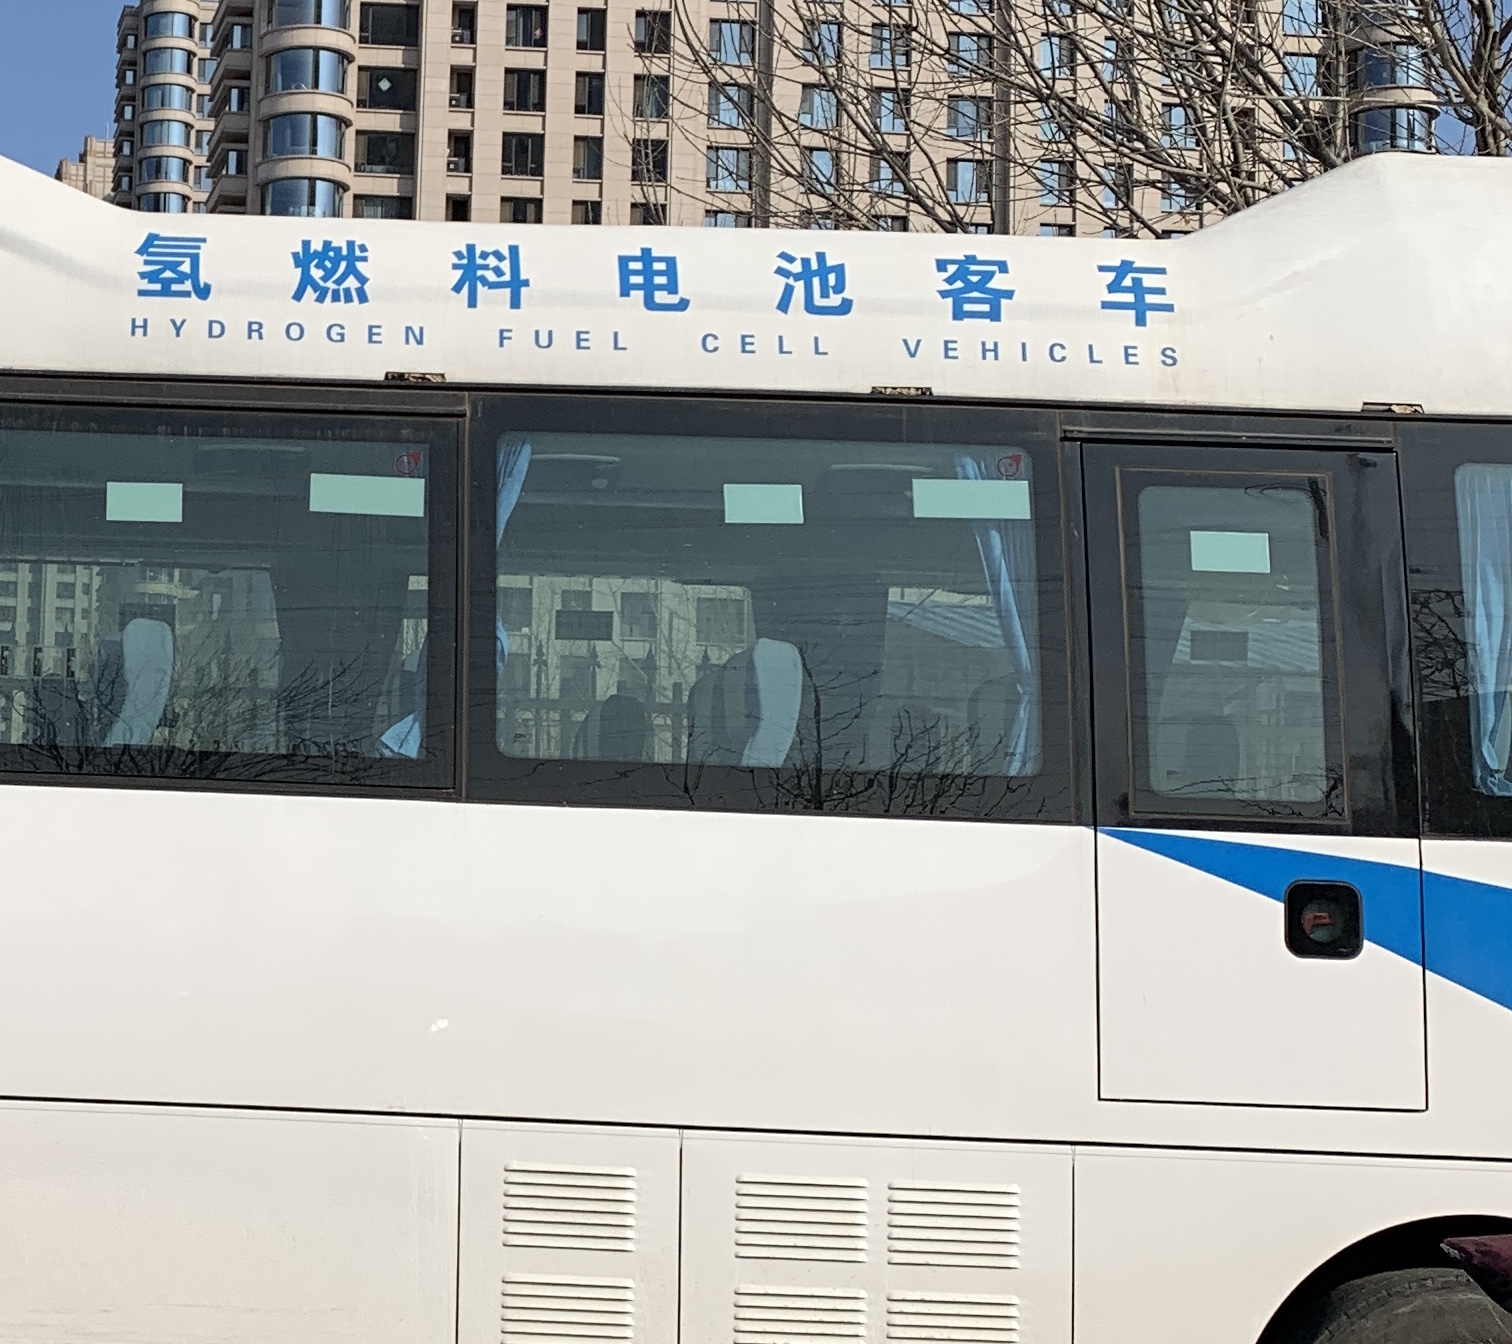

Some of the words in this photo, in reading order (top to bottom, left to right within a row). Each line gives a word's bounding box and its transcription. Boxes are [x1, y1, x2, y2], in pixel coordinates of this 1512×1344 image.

[133, 232, 1175, 327] 氢燃料电池客车
[130, 318, 426, 346] HYDROGEN
[498, 328, 629, 351] FUEL
[701, 333, 830, 357] CELL
[903, 338, 1180, 367] VEHICLES
